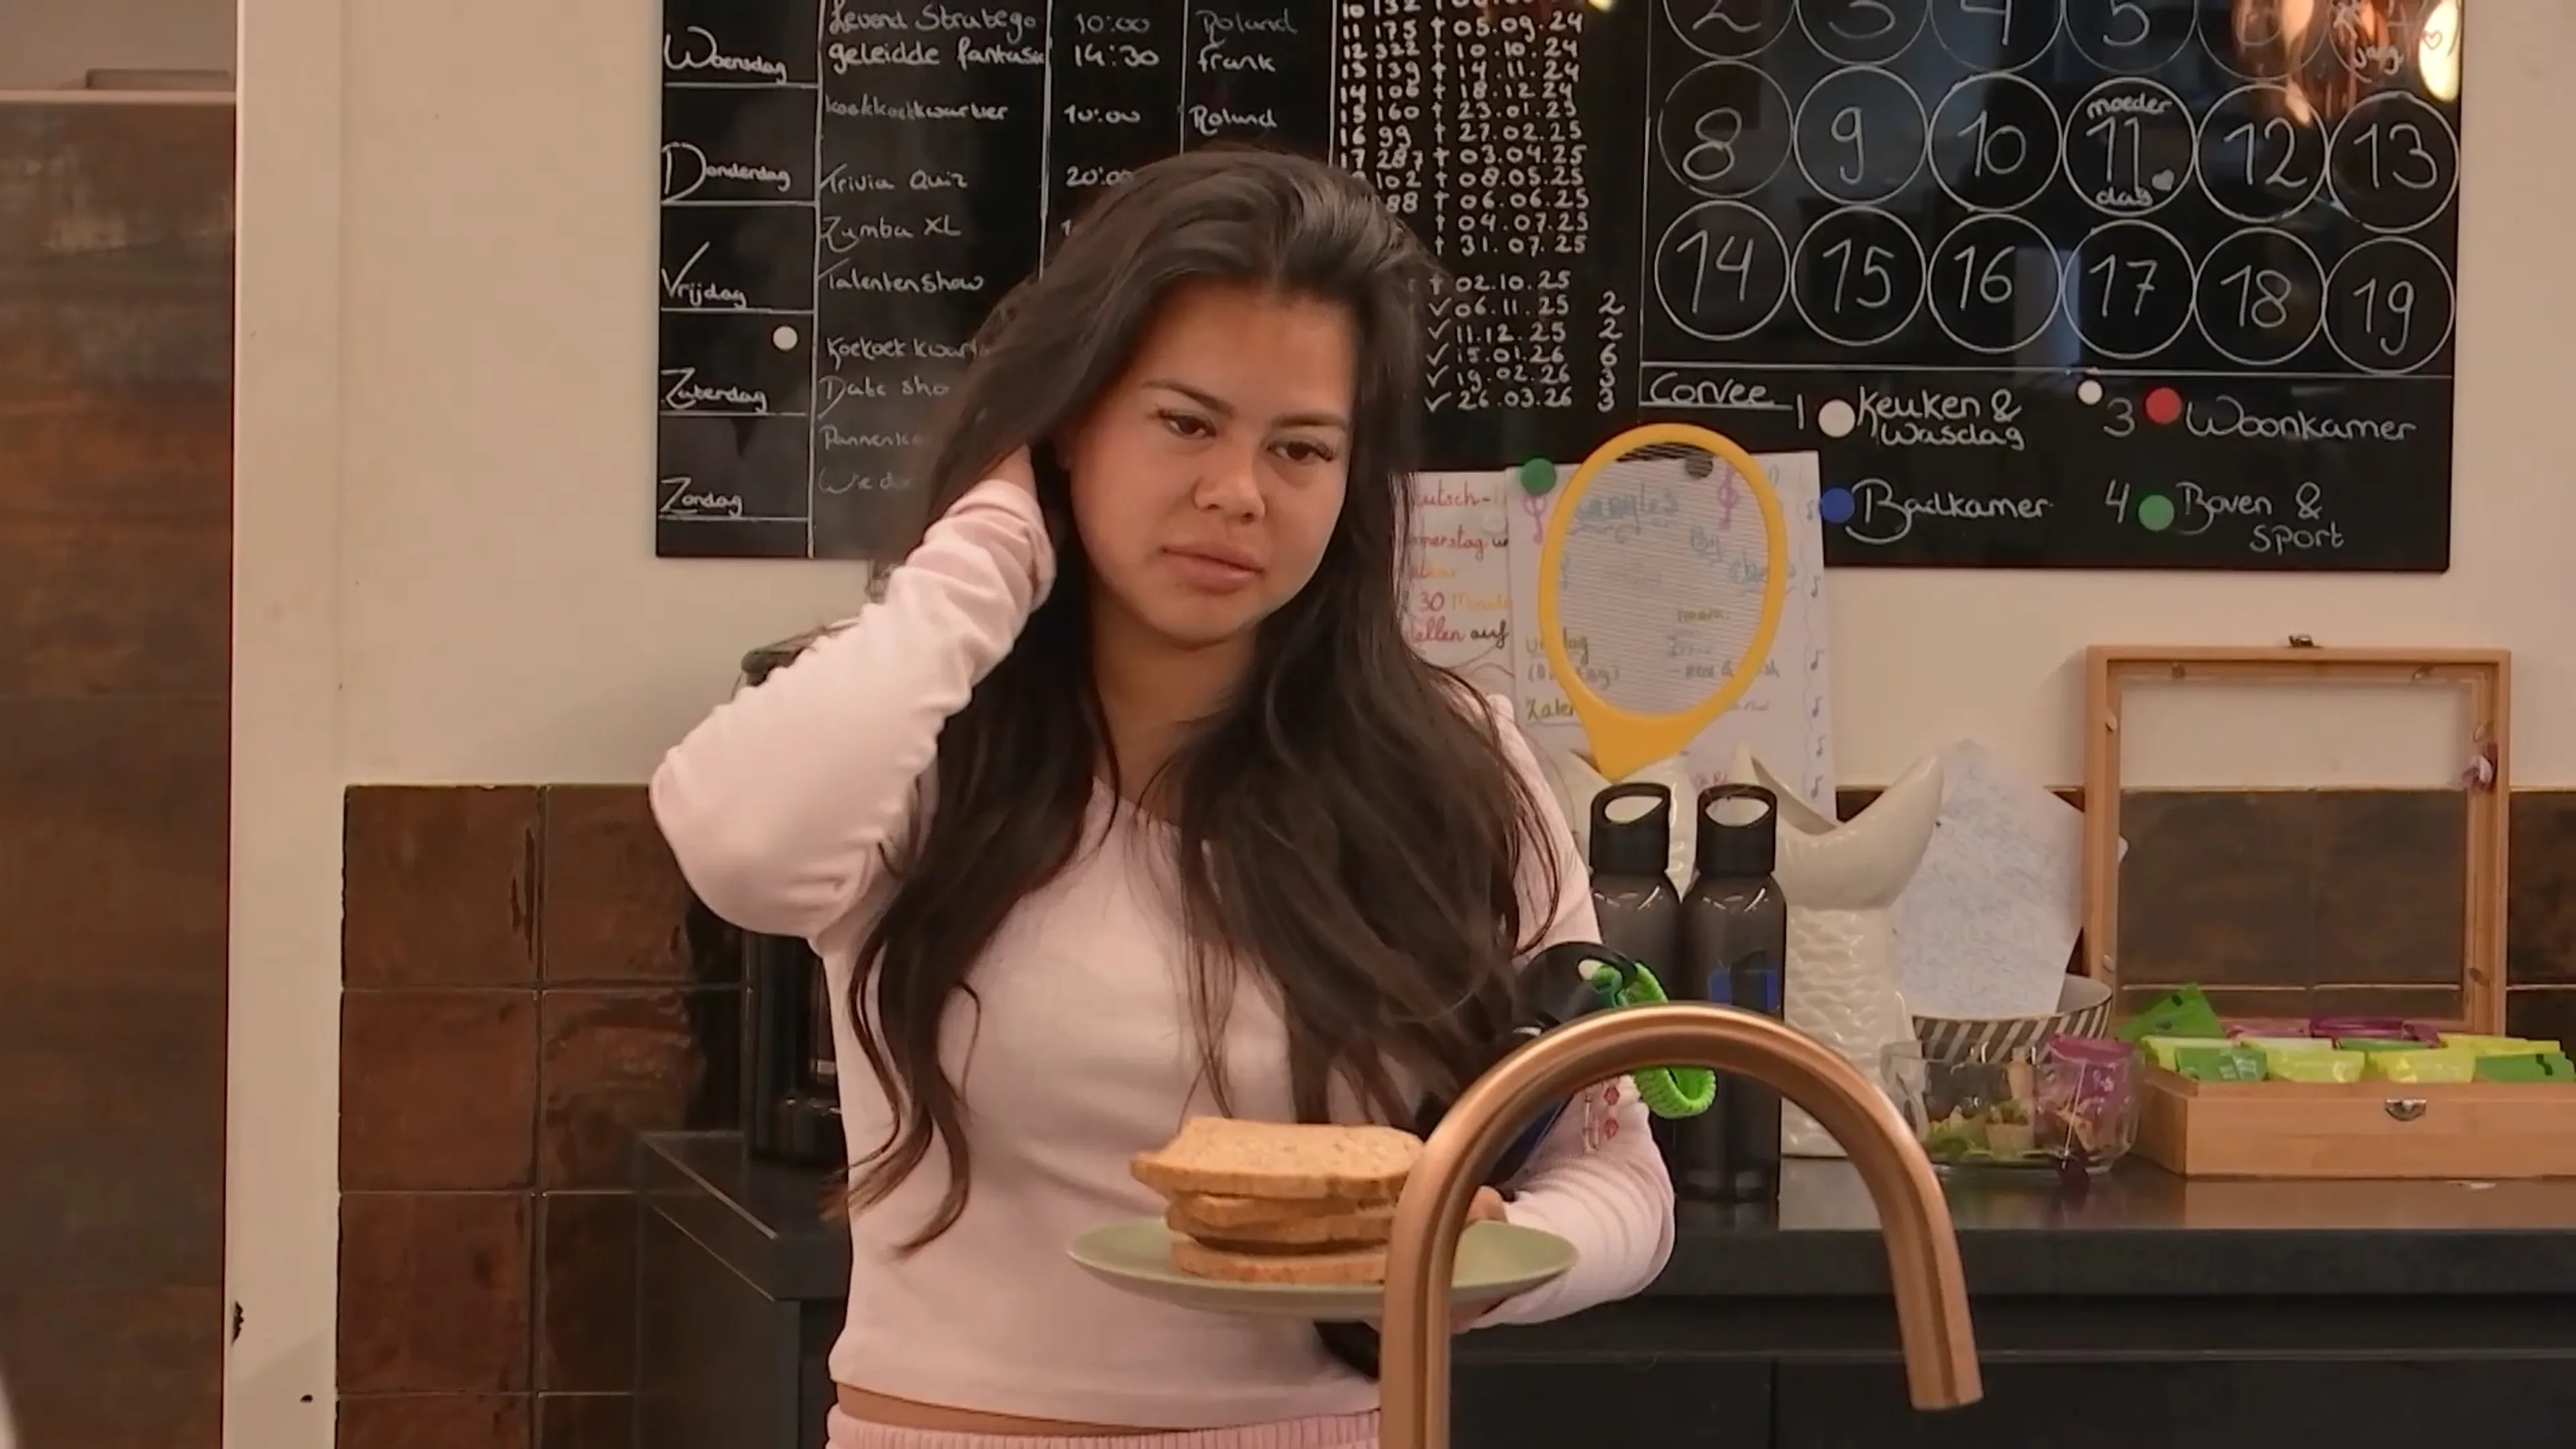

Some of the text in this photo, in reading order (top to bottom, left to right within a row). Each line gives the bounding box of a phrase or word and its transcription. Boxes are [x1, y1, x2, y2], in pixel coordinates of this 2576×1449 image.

[915, 3, 1036, 44] Stratego
[1076, 13, 1150, 34] 10:00
[1195, 8, 1297, 44] Roland
[1342, 23, 1360, 40] 11
[1375, 19, 1417, 41] 175
[663, 27, 787, 83] Woensdag
[828, 40, 940, 75] geleidde
[1075, 44, 1160, 68] 14:30
[1343, 36, 1578, 60] 12 322 10.10.24
[1342, 58, 1580, 85] 13 139 14.11.24
[1340, 83, 1366, 105] 14
[1460, 80, 1572, 101] 18.12.24
[2086, 93, 2172, 120] moeder
[1064, 104, 1140, 123] 10:00
[1189, 104, 1277, 136] Roland
[1340, 104, 1366, 124] 15
[1377, 101, 1419, 122] 160
[1340, 119, 1582, 148] 16 99 27.02.25
[1682, 107, 1741, 180] 8
[1831, 107, 1864, 185] 9
[1957, 111, 2026, 177] 10
[1459, 143, 1587, 166] 03.04.25
[2086, 115, 2141, 191] 11
[2224, 117, 2308, 187] 12
[2354, 123, 2438, 189] 13
[661, 142, 791, 202] Donderdag
[820, 163, 967, 193] Trivia Quiz
[1377, 170, 1421, 190] 102
[1458, 165, 1584, 189] 08.05.25
[1460, 187, 1589, 210] 06.06.25
[821, 215, 961, 252] Zumba XL
[1458, 211, 1589, 234] 04.07.25
[1460, 234, 1587, 258] 31.07.25
[661, 241, 747, 309] Vrijdag
[1456, 270, 1571, 292] 02.10.25
[1676, 231, 1754, 313] 14
[1823, 238, 1895, 313] 15
[1953, 245, 2015, 310] 16
[2088, 254, 2157, 317] 17
[1454, 290, 1625, 318] 06.11.25 2
[2220, 265, 2291, 328] 18
[1456, 317, 1623, 343] 11.12.25 2
[2353, 278, 2414, 356] 19
[1457, 343, 1618, 366] 15.01.26 6
[660, 366, 767, 413] Zaterdag
[1457, 364, 1615, 394] 19.02.26 3
[1650, 372, 1774, 404] Corvee
[818, 375, 887, 421] Date
[1458, 386, 1615, 413] 26.03.26 3
[1858, 386, 1980, 437] Keuken
[1992, 388, 2022, 423] &
[2103, 394, 2416, 441] 3 Woonkamer
[659, 478, 743, 517] Zondag
[1845, 478, 2053, 545] Badkamer
[2104, 479, 2322, 535] 4 Boven &
[1421, 590, 1445, 612] 30
